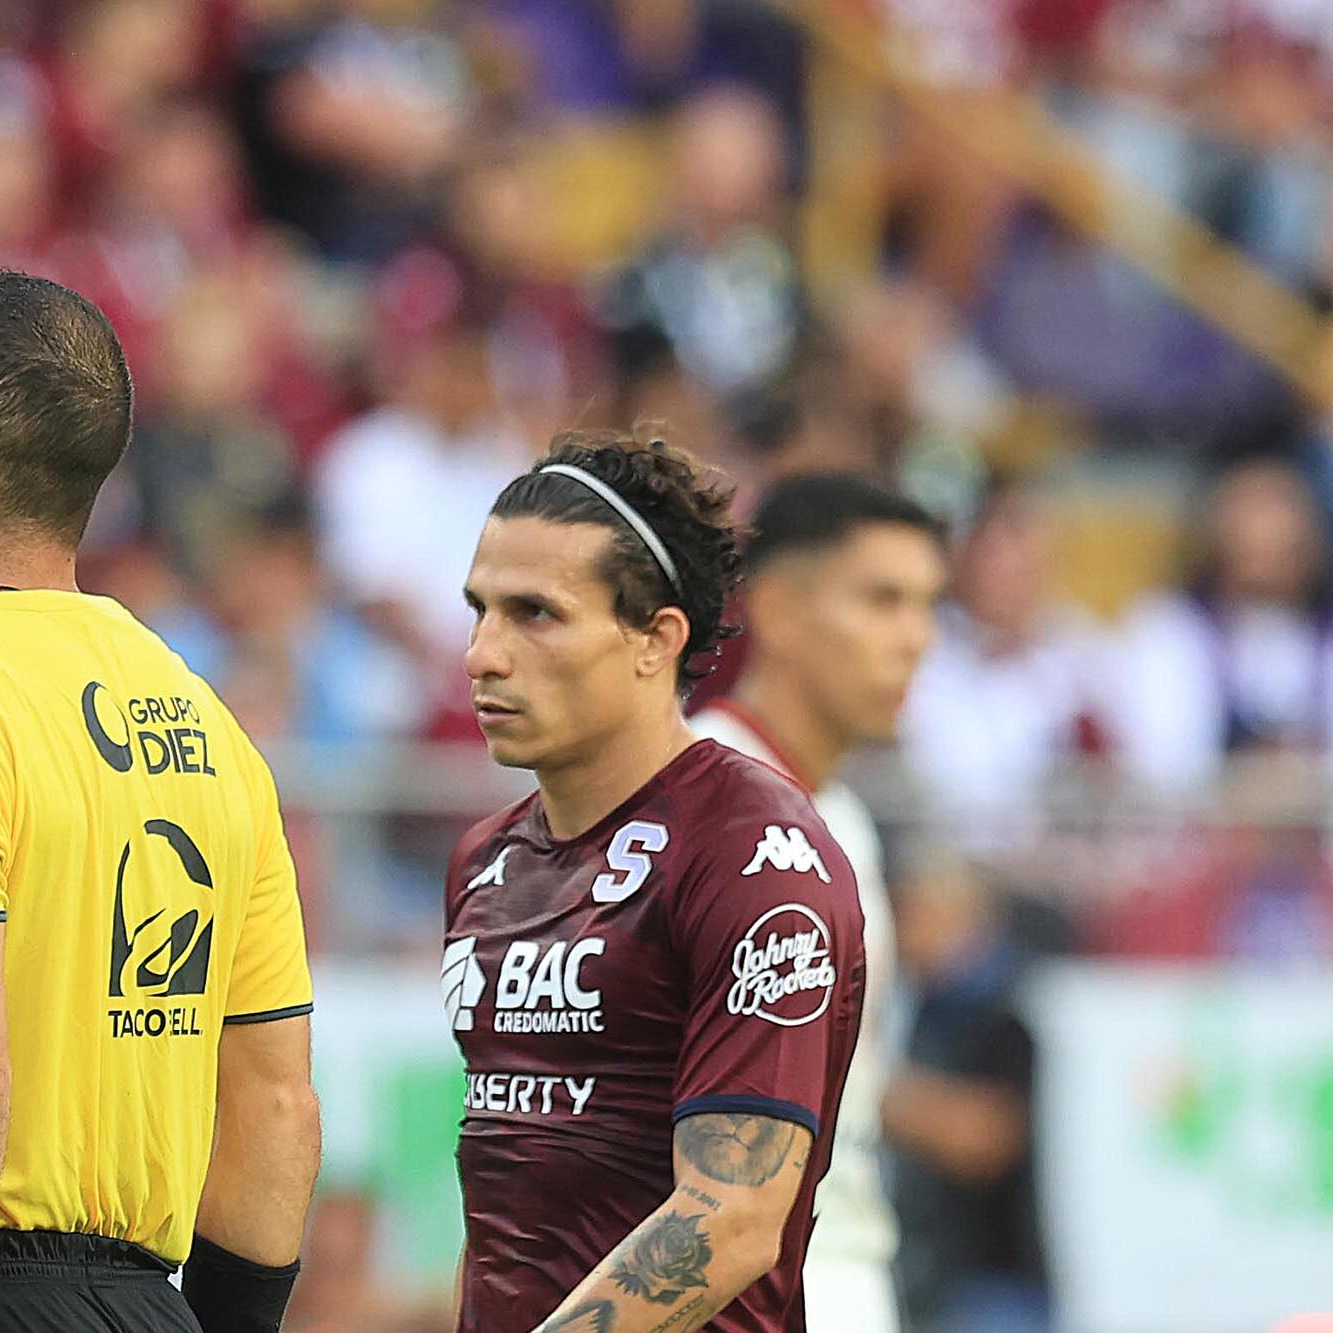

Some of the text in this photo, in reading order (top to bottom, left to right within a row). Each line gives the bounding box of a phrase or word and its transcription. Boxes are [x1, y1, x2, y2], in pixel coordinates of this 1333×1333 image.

[128, 697, 200, 724] GRUPO
[137, 728, 216, 777] DIEZ
[590, 819, 670, 903] S
[495, 937, 606, 1010] BAC
[108, 1008, 167, 1038] TACO
[493, 1009, 606, 1034] CREDOMATIC
